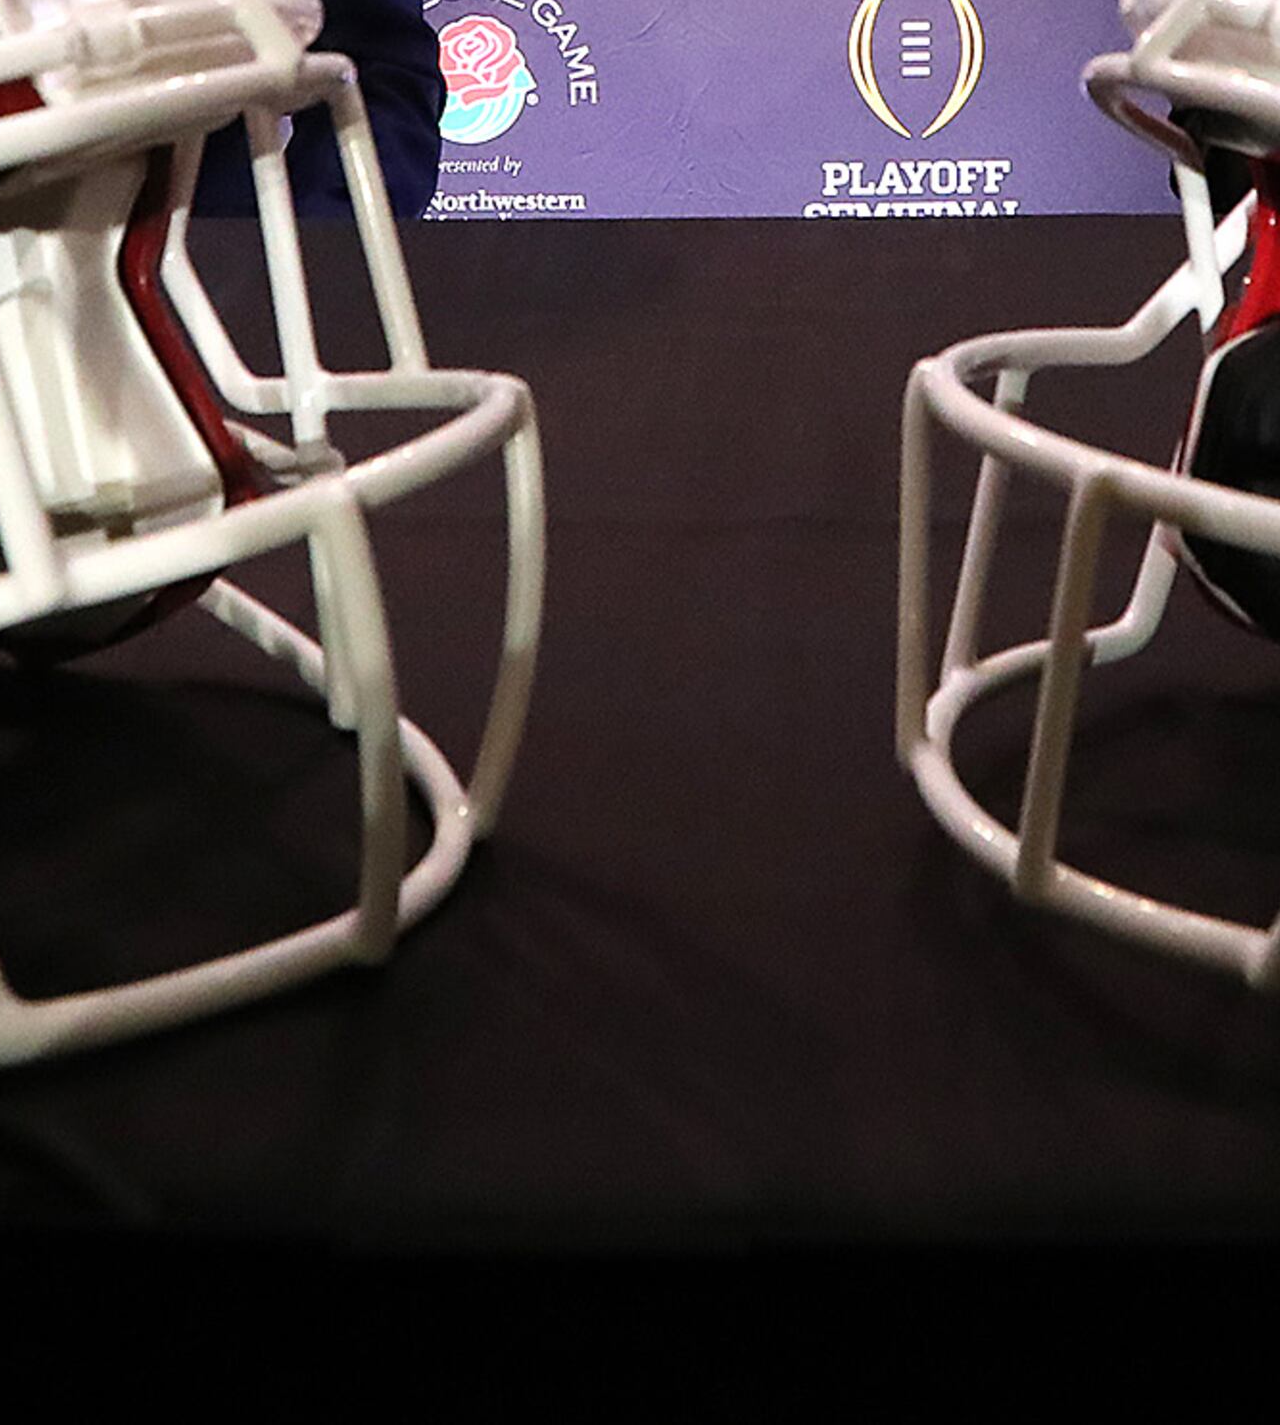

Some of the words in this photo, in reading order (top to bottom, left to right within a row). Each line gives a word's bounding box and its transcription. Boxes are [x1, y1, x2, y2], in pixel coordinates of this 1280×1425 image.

[438, 156, 499, 174] resented
[503, 155, 522, 176] by
[822, 161, 1010, 195] PLAYOFF
